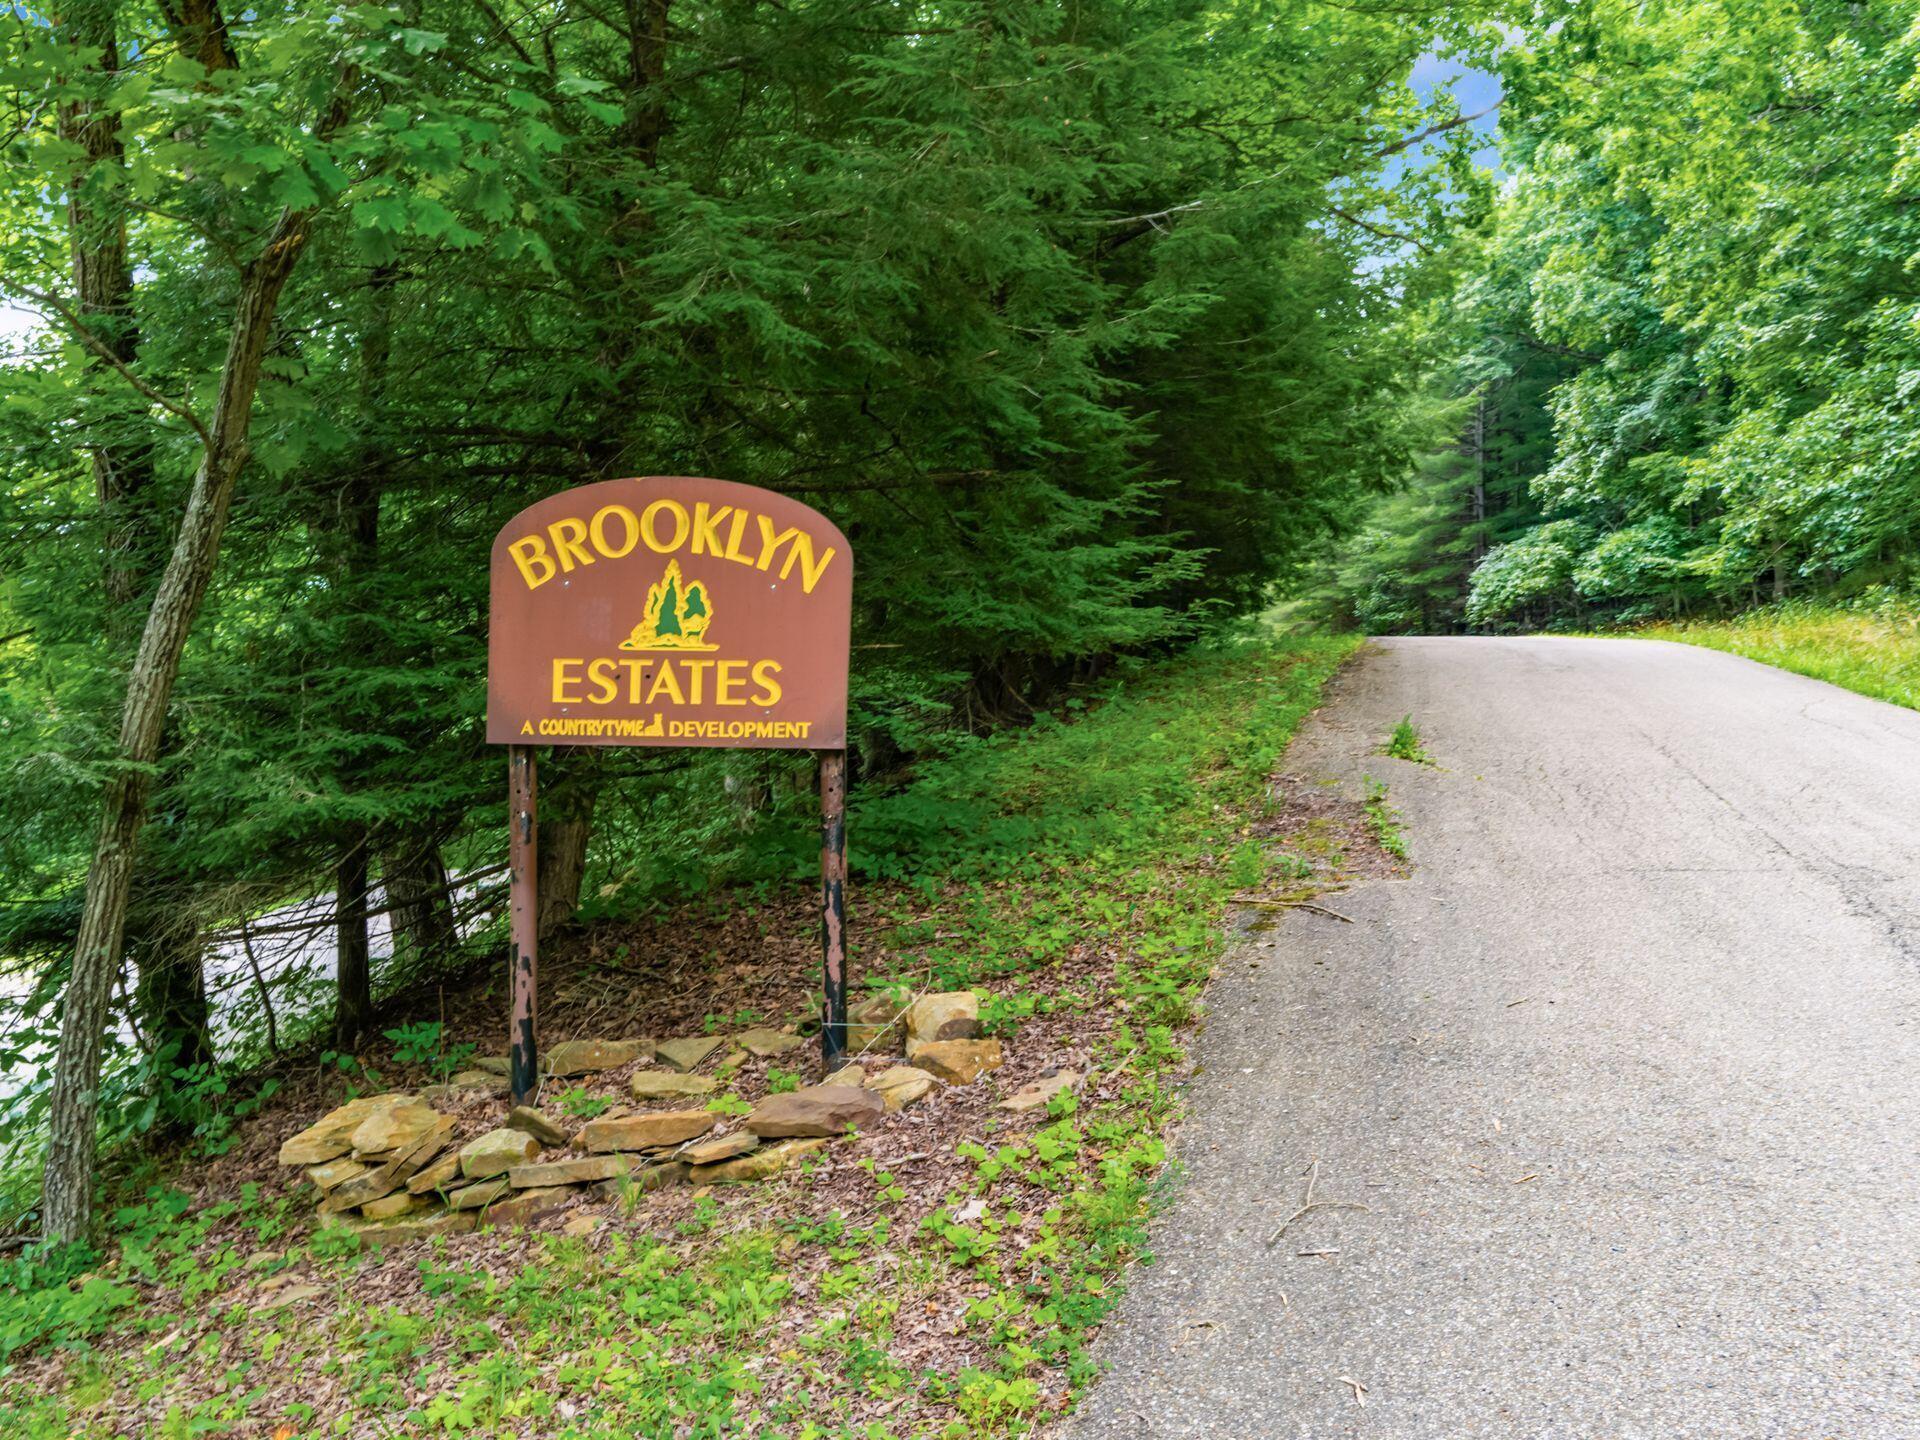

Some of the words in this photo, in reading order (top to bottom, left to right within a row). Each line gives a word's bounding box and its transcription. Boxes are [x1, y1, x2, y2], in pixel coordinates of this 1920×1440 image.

[507, 499, 836, 594] BROOKLYN
[551, 658, 783, 706] ESTATES
[520, 719, 535, 736] A
[538, 718, 645, 738] COUNTRYTYME
[668, 720, 812, 739] DEVELOPMENT
